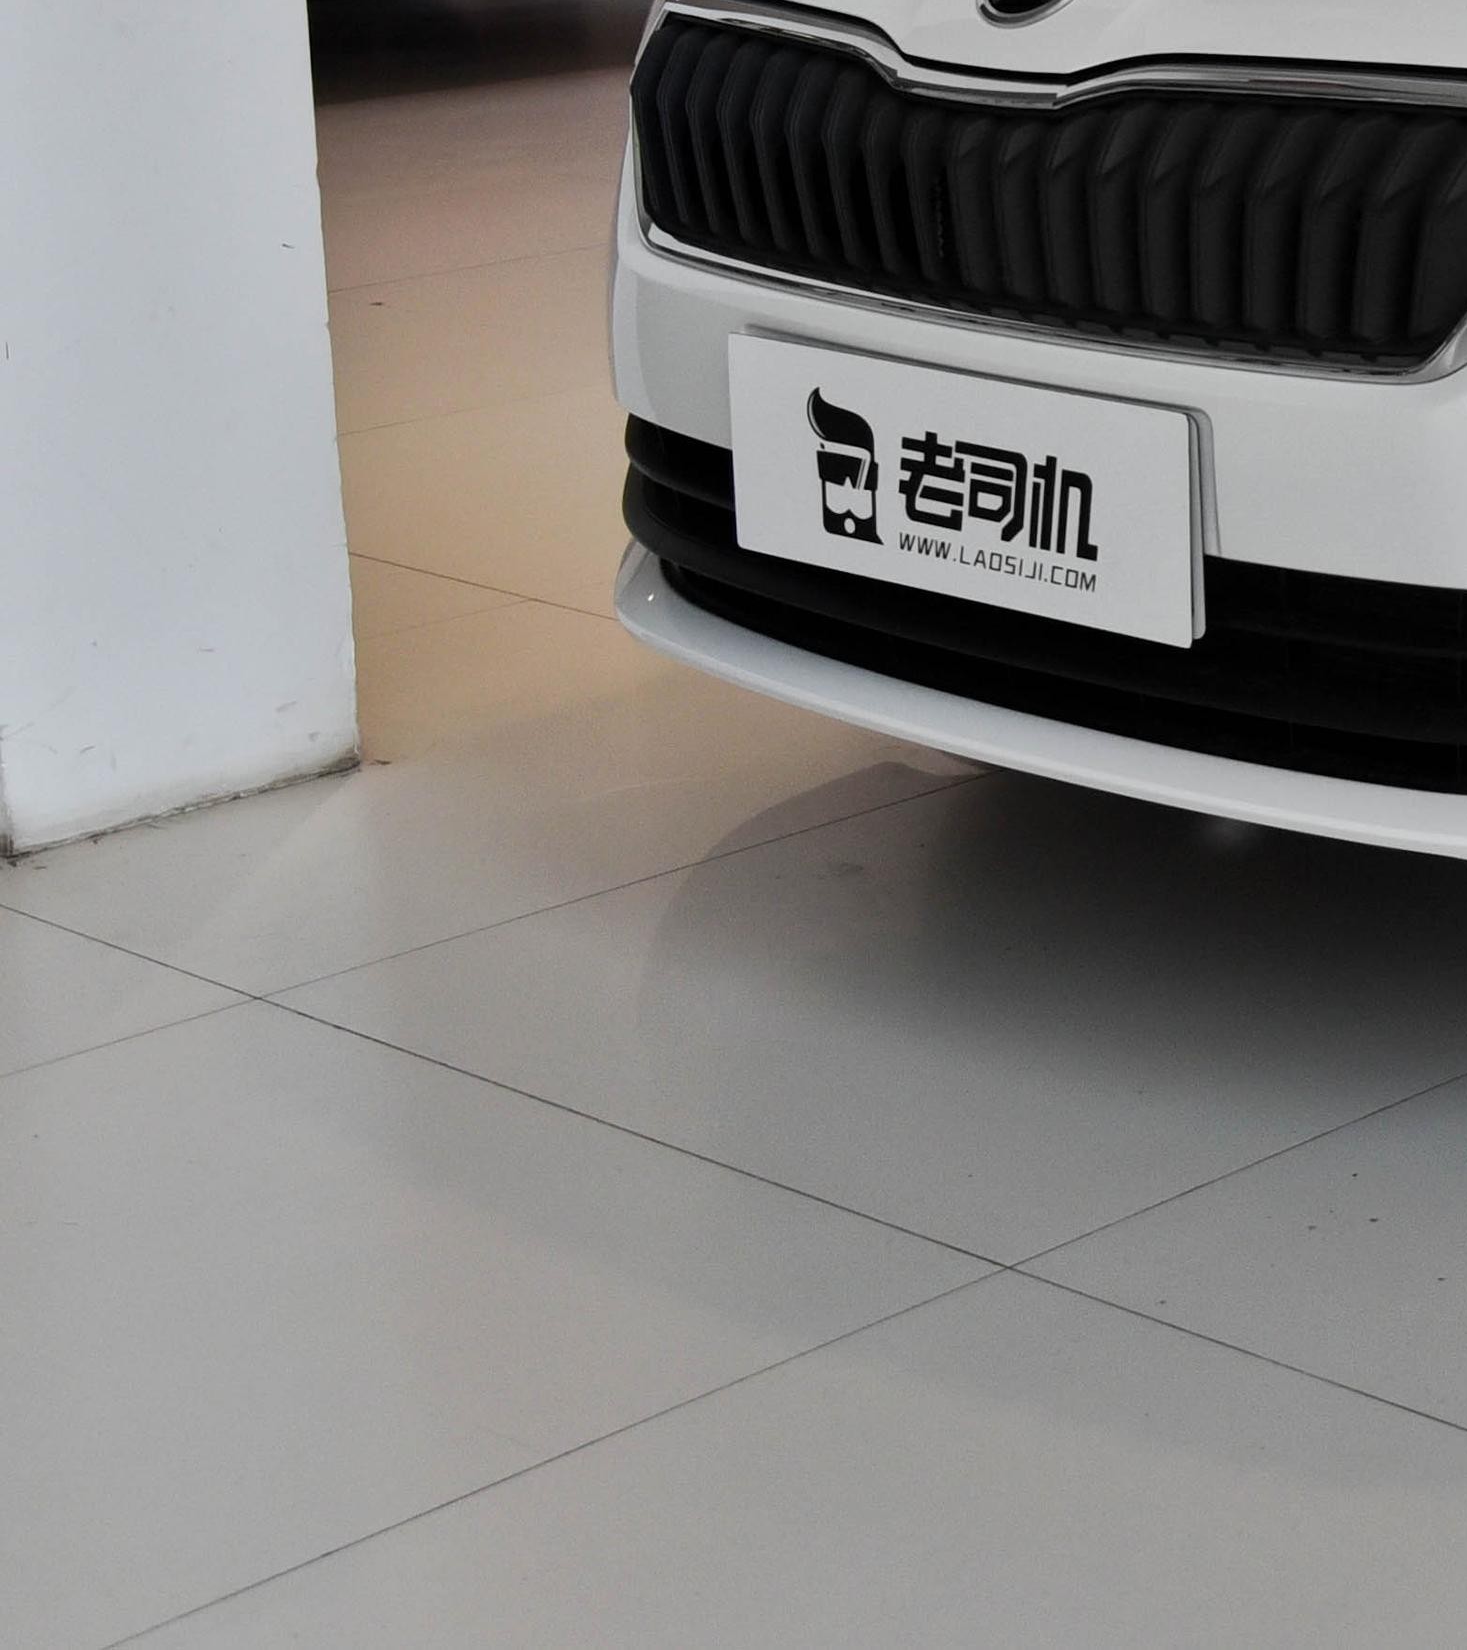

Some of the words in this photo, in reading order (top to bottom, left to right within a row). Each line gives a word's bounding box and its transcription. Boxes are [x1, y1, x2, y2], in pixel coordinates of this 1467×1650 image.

[898, 430, 1099, 562] 老司机
[898, 531, 1098, 593] WWW.LAOSIJI.COM
